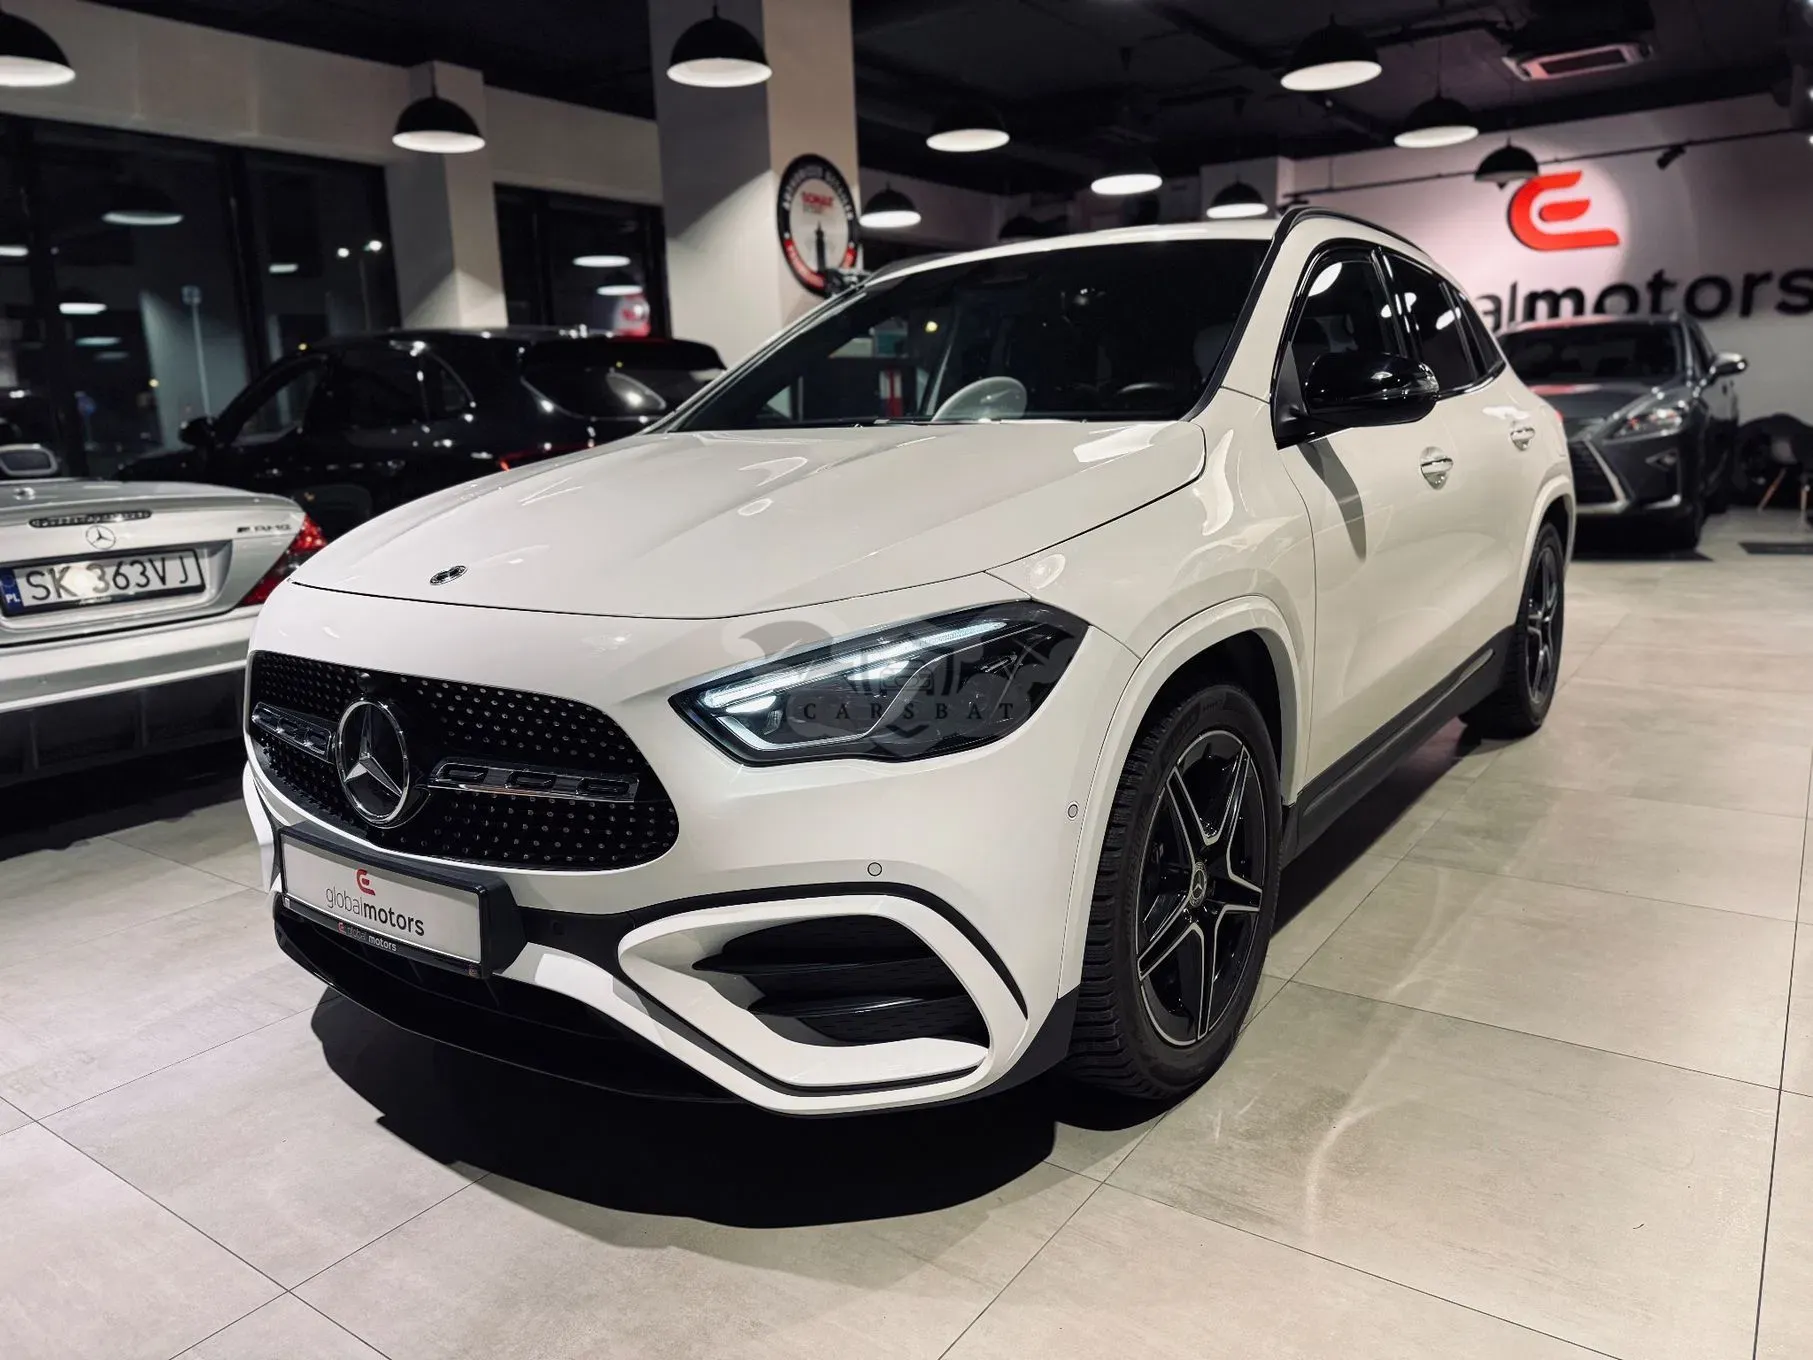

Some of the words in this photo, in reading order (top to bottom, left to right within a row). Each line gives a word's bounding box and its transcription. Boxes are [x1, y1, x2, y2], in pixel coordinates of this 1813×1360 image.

[26, 565, 78, 601] SK
[86, 556, 188, 594] 363VJ
[5, 593, 20, 604] PL
[325, 885, 425, 937] globalmotors
[368, 935, 397, 952] motors
